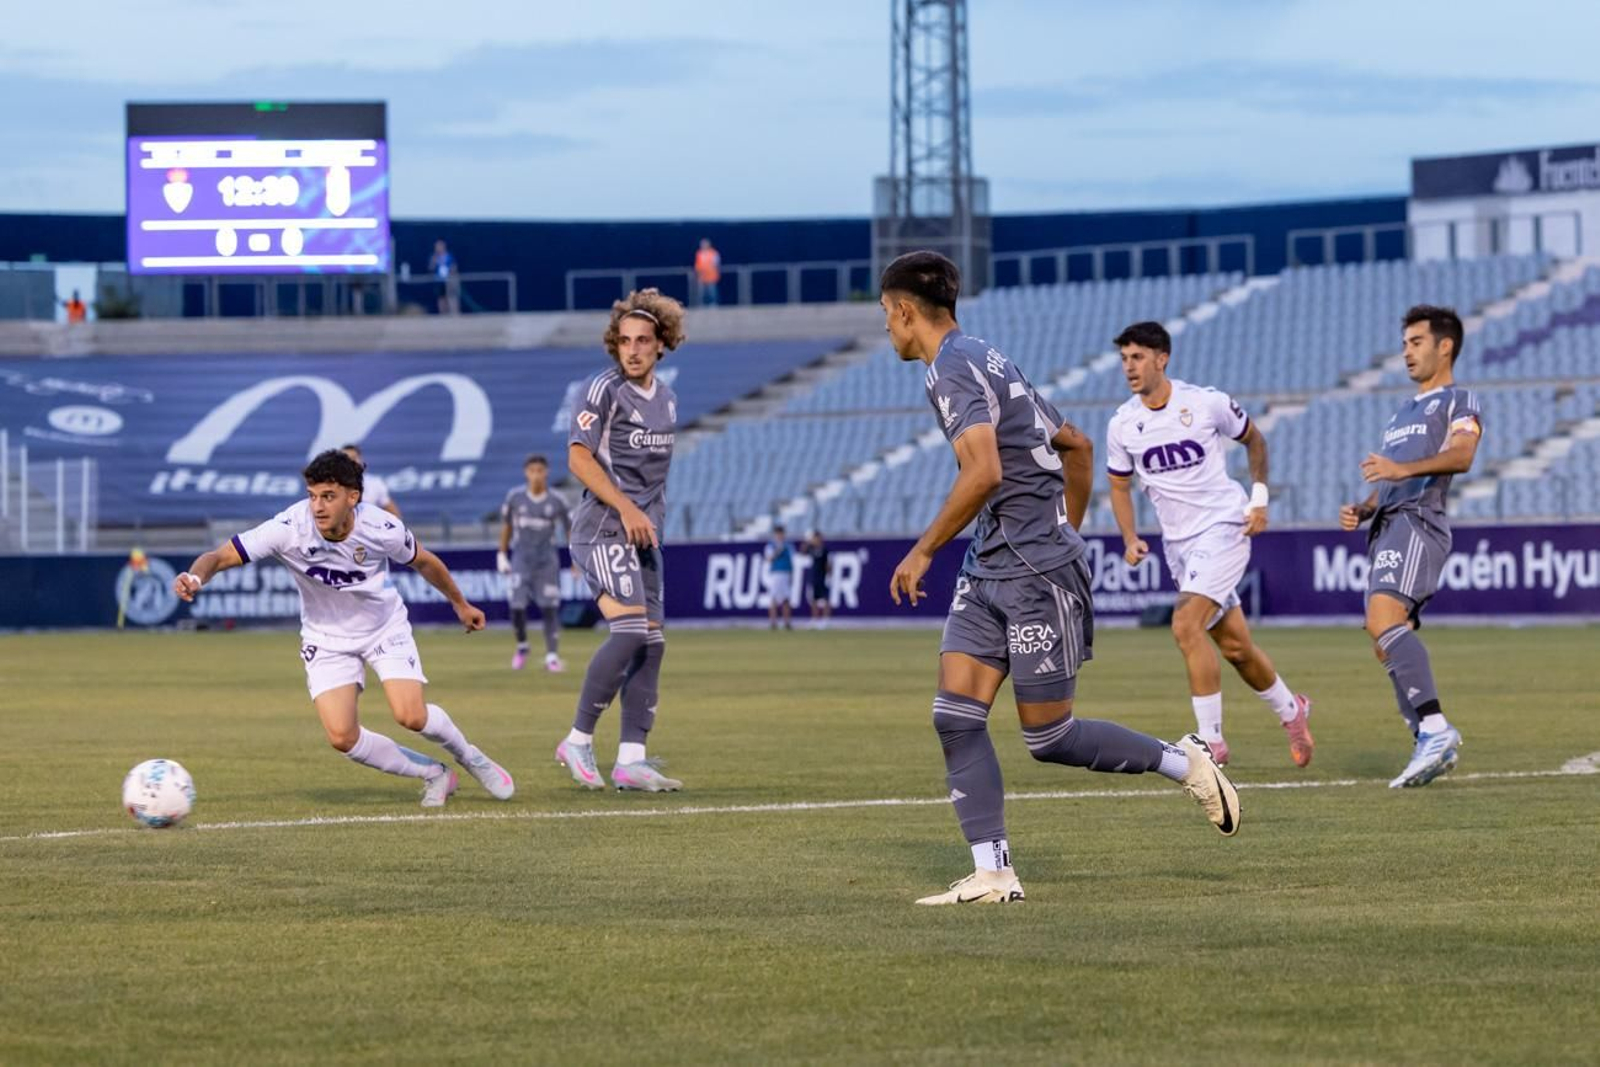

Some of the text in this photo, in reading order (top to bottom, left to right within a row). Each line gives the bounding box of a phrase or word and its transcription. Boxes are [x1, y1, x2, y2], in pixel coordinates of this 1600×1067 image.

[383, 464, 477, 493] én!
[704, 552, 861, 609] RUTR
[1437, 540, 1517, 591] aén
[1010, 640, 1053, 654] GRUPO
